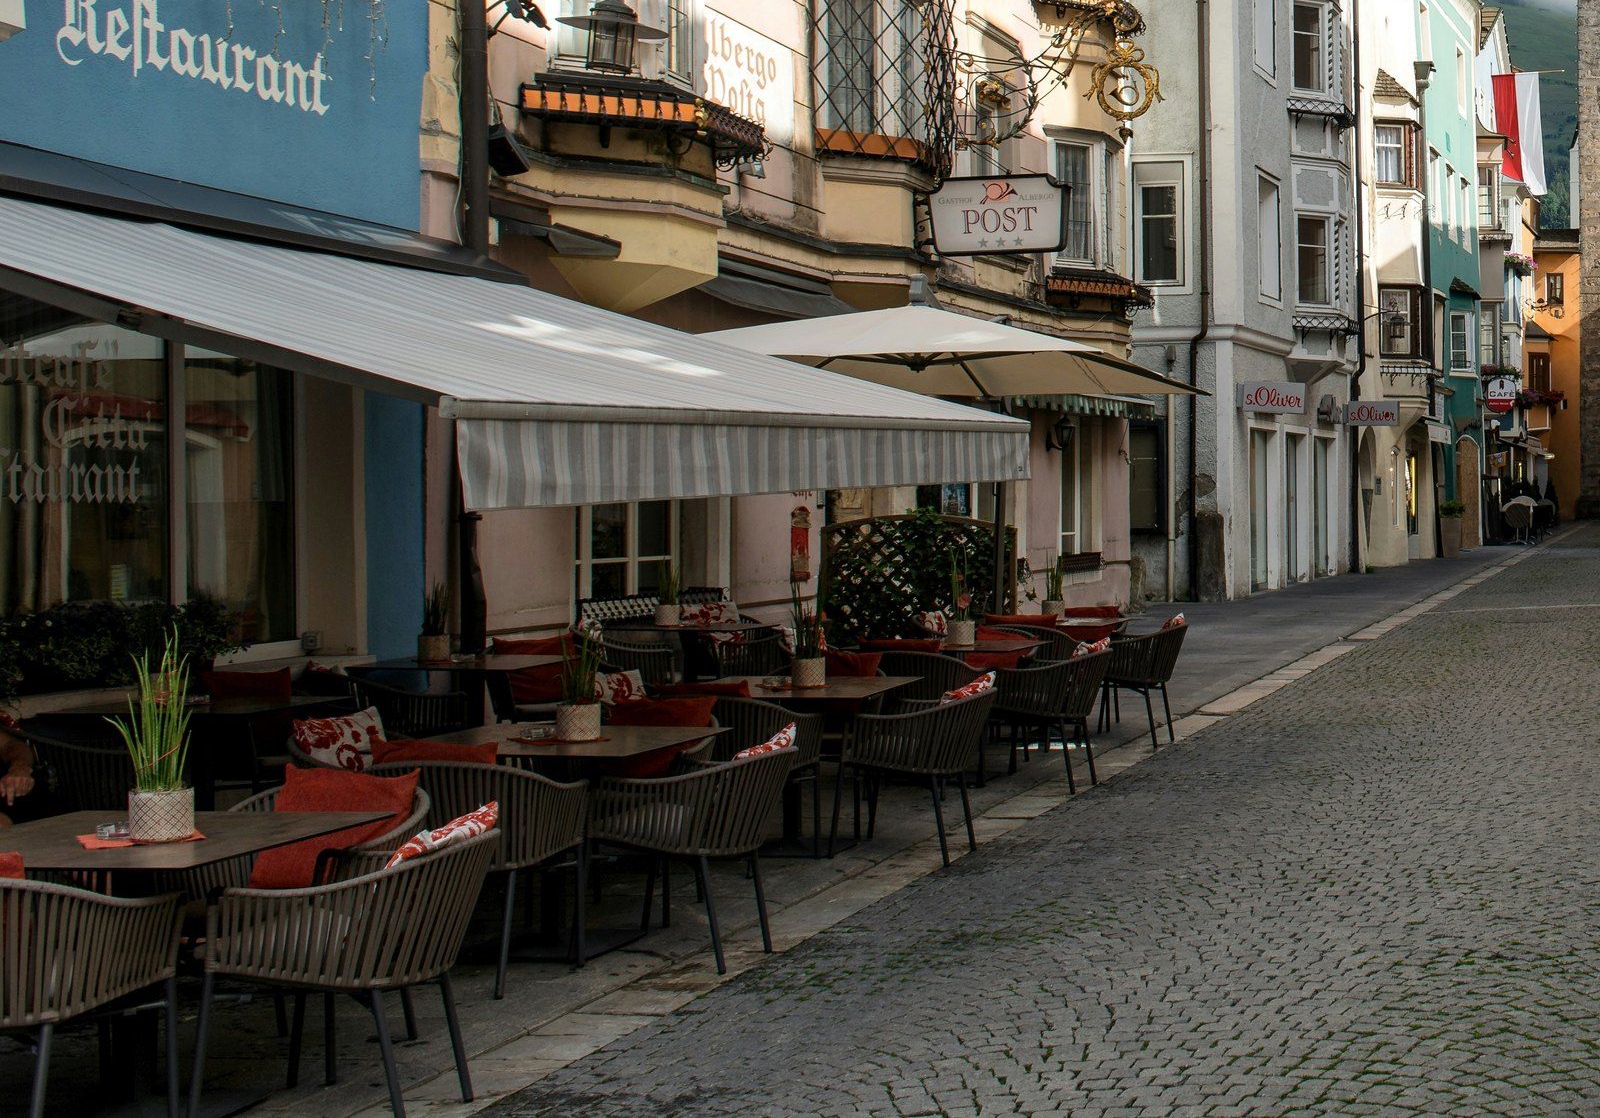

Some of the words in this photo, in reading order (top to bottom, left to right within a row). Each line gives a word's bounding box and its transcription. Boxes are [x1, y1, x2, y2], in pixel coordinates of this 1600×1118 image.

[938, 196, 973, 205] GASTHOF
[1018, 193, 1055, 202] ALBERGO
[962, 206, 1038, 234] POST
[1245, 386, 1302, 408] s.Oliver
[1350, 405, 1397, 423] s.Oliver
[0, 446, 142, 504] taurant
